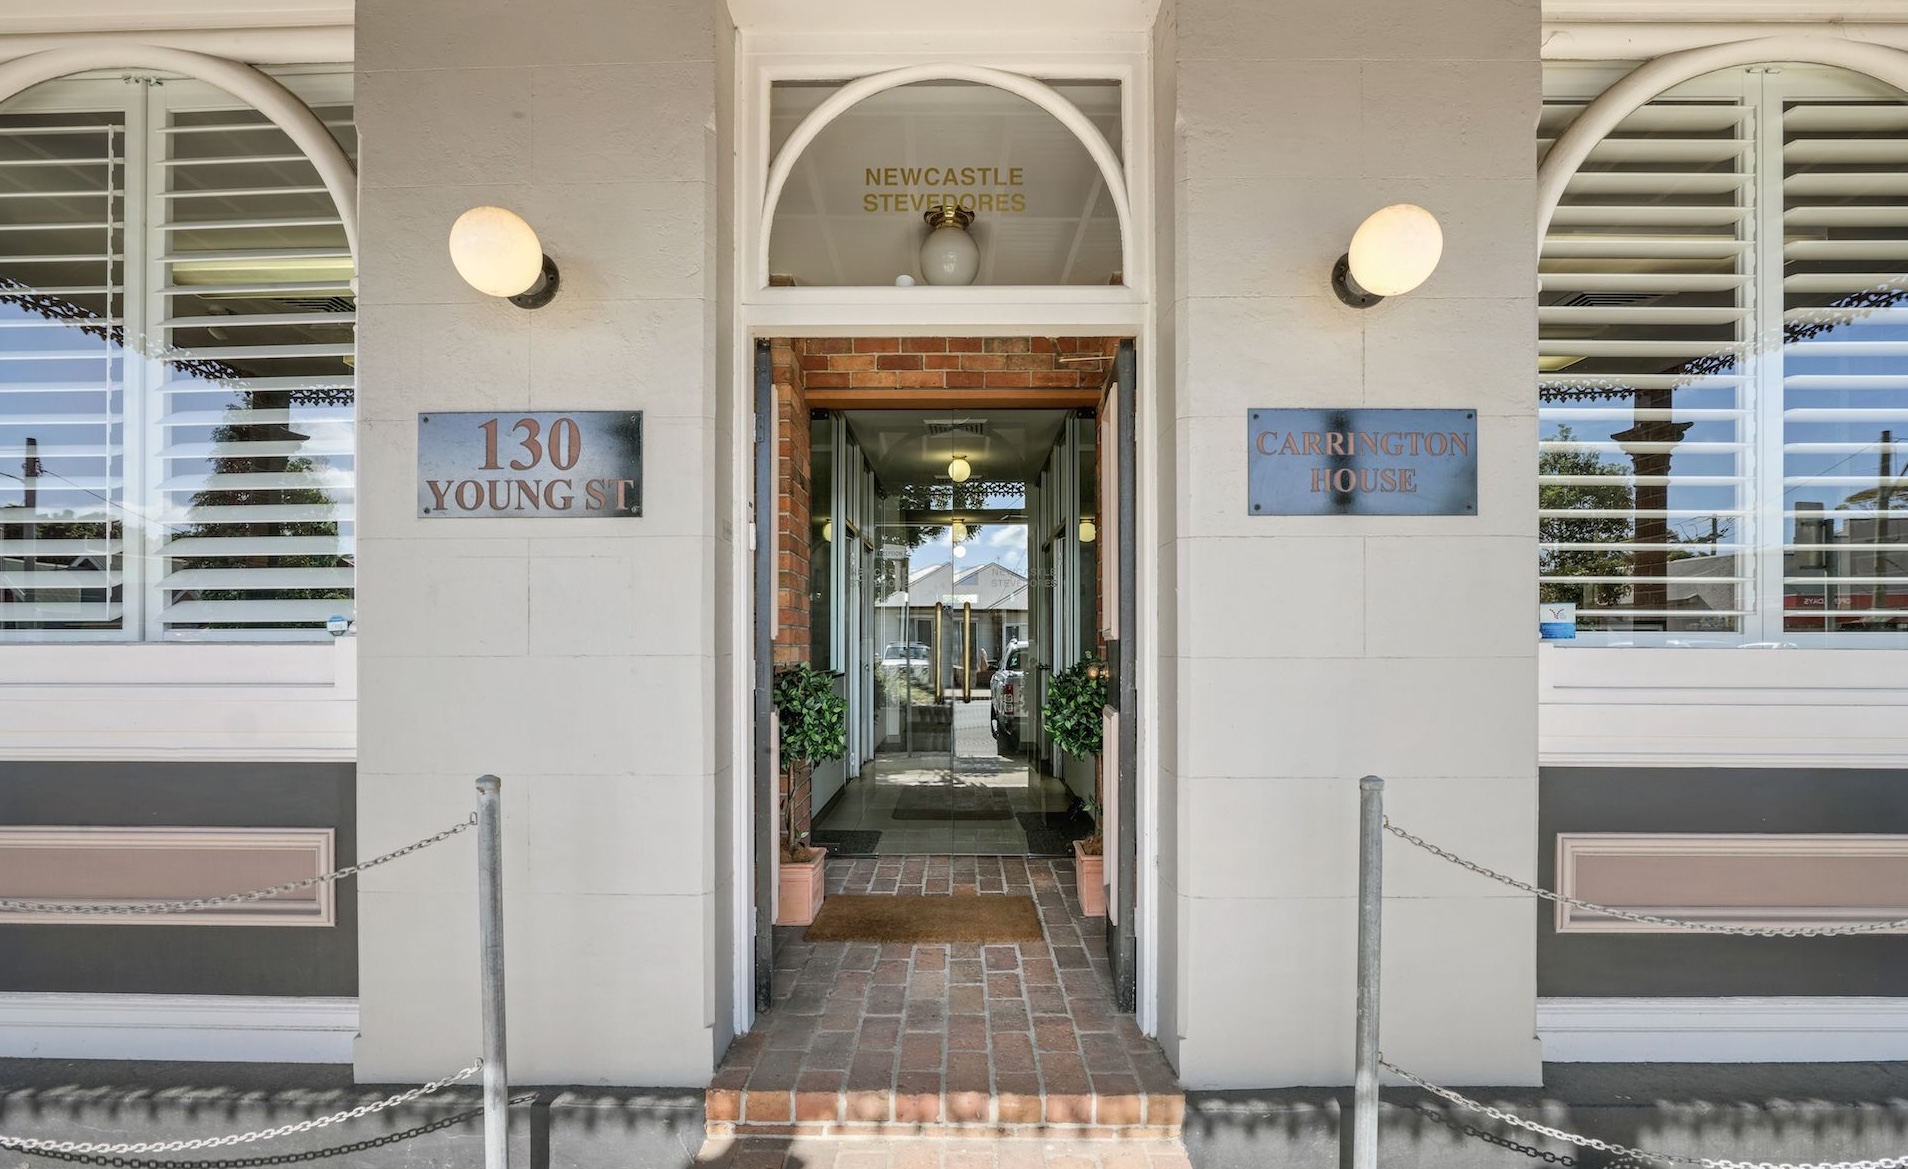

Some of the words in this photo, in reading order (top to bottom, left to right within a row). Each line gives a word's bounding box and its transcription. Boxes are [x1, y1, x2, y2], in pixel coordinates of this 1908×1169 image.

[865, 168, 1024, 186] NEWCASTLE
[863, 194, 1026, 212] STEVEDORES
[478, 418, 581, 471] 130
[1256, 431, 1469, 456] CARRINGTON
[1311, 468, 1417, 492] HOUSE
[426, 479, 575, 511] YOUNG
[585, 479, 634, 510] ST
[991, 579, 1057, 588] STEVEOES
